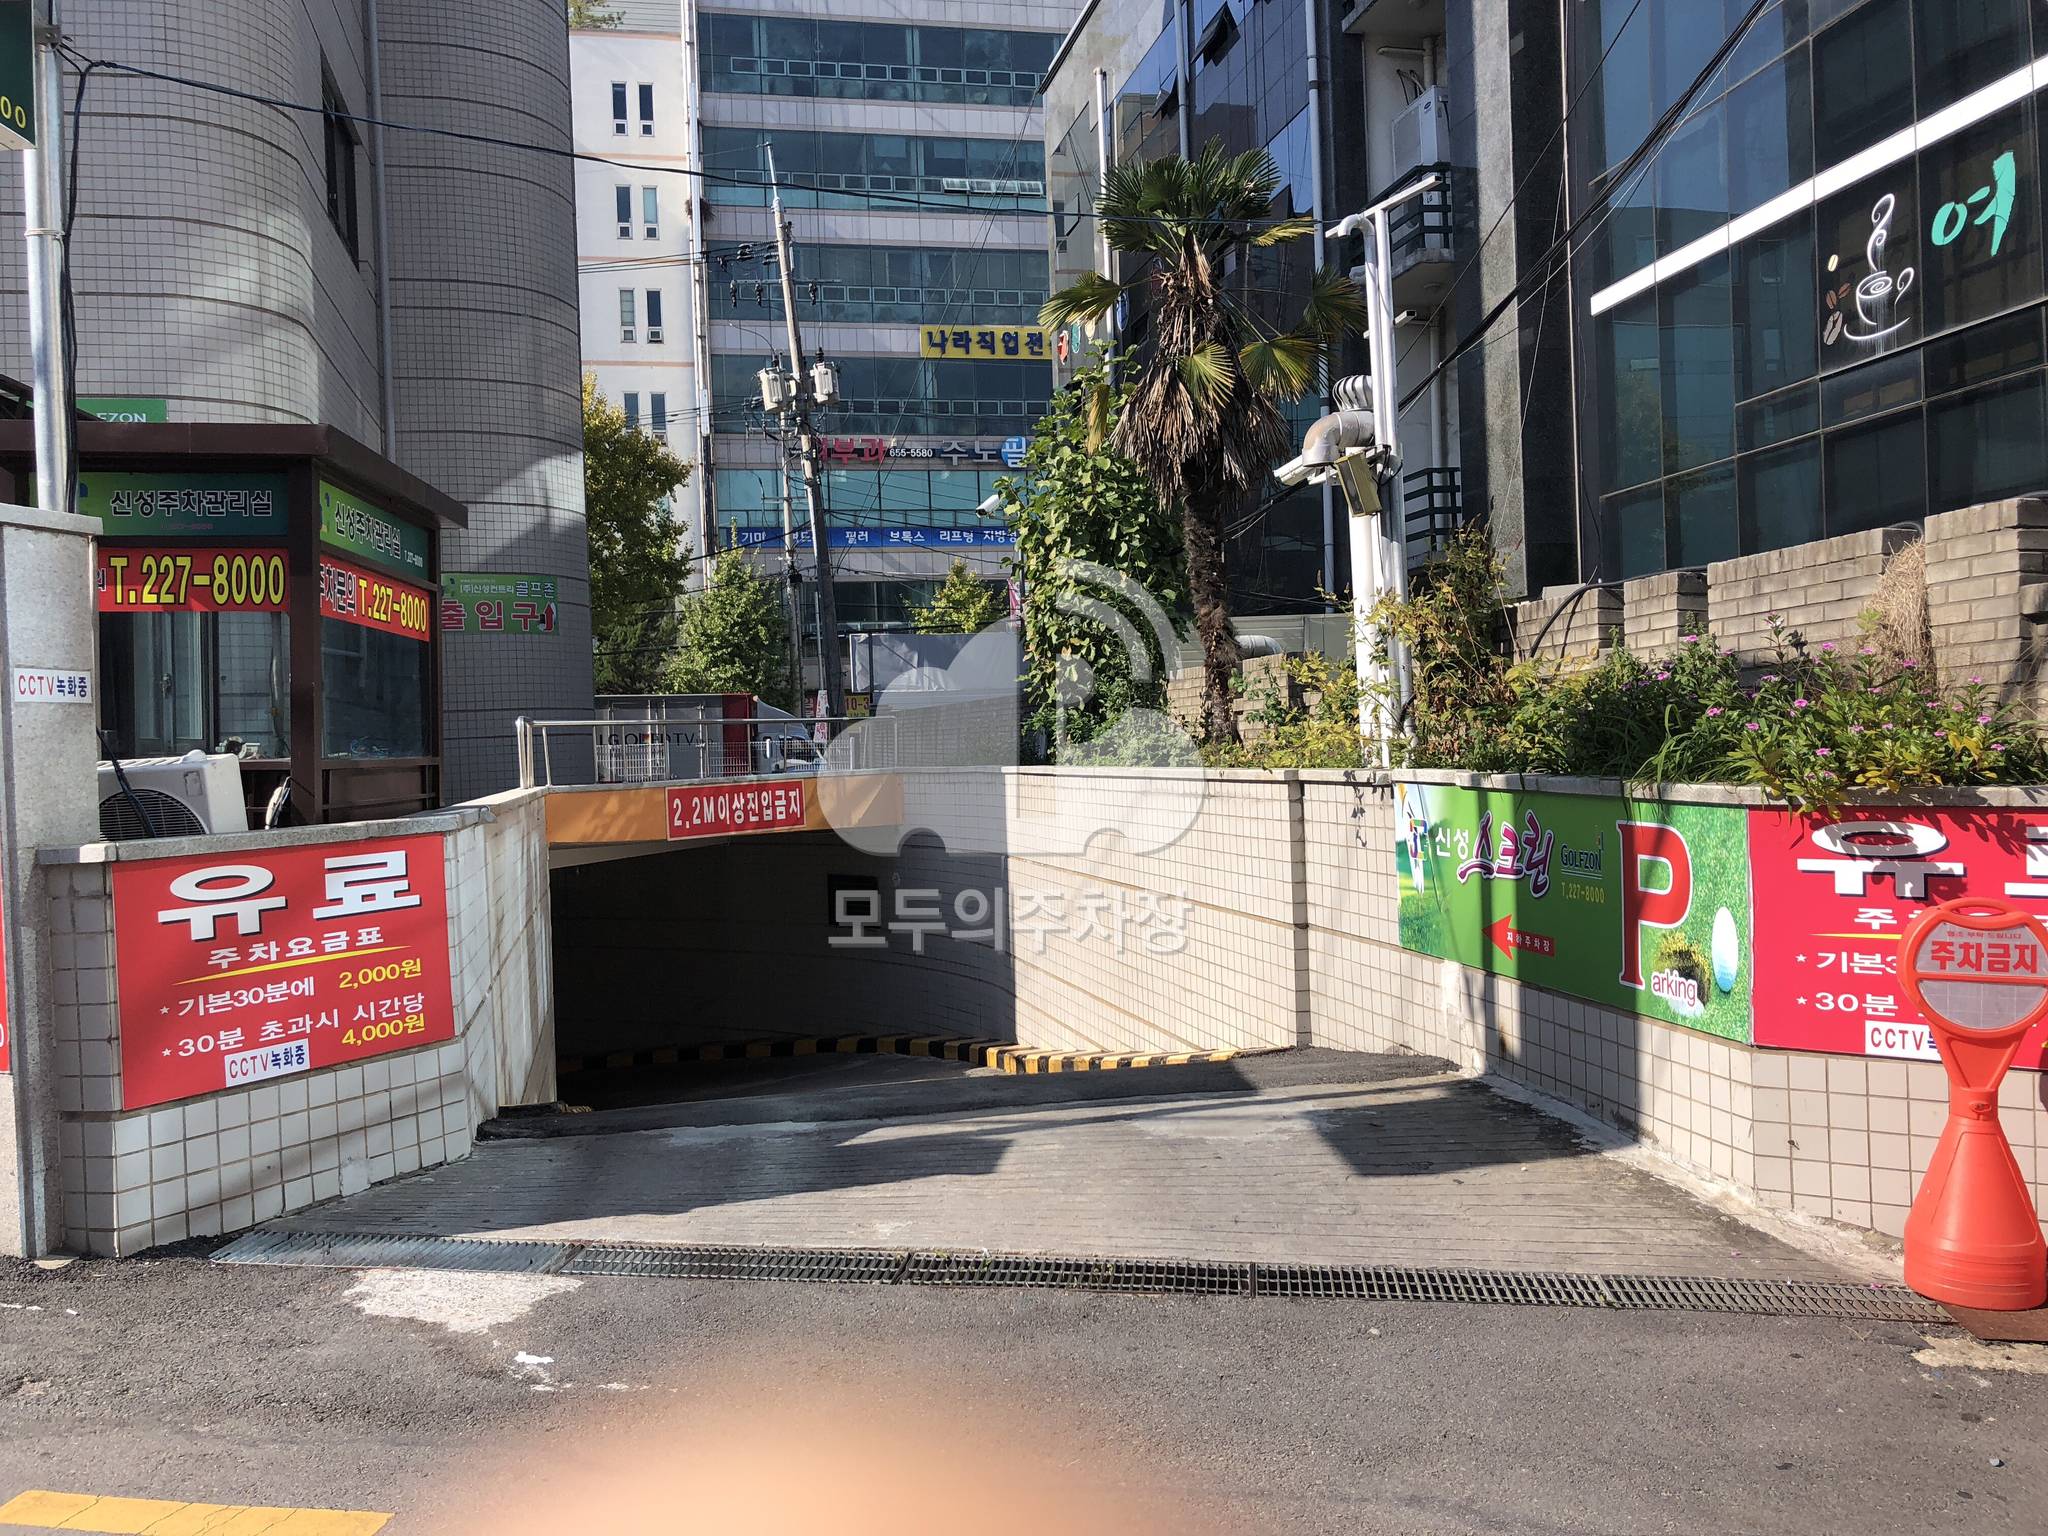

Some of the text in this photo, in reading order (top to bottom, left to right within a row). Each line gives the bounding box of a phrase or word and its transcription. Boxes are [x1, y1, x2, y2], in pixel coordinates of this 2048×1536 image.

[1932, 151, 2016, 257] 여
[927, 330, 1052, 356] 나라직업전
[889, 448, 933, 457] 655-5580
[110, 489, 273, 518] 신성주차관리실
[335, 499, 401, 560] 신성주차관리실
[109, 554, 286, 606] T.227-8000
[358, 577, 428, 633] T.227-8000
[441, 599, 541, 632] 출입구
[1435, 810, 1554, 898] 신성 스크린
[157, 850, 422, 941] 유료
[1562, 881, 1606, 904] T.227-8000
[207, 926, 384, 969] 주차요금표
[1506, 931, 1551, 952] 지하주차장
[1930, 940, 2038, 974] 주차금지
[178, 958, 423, 1017] 기본30분에 2,000원
[1815, 992, 1899, 1017] 30분
[178, 993, 425, 1058] 30분 초과시 시간당
[341, 1013, 426, 1047] 4,000원
